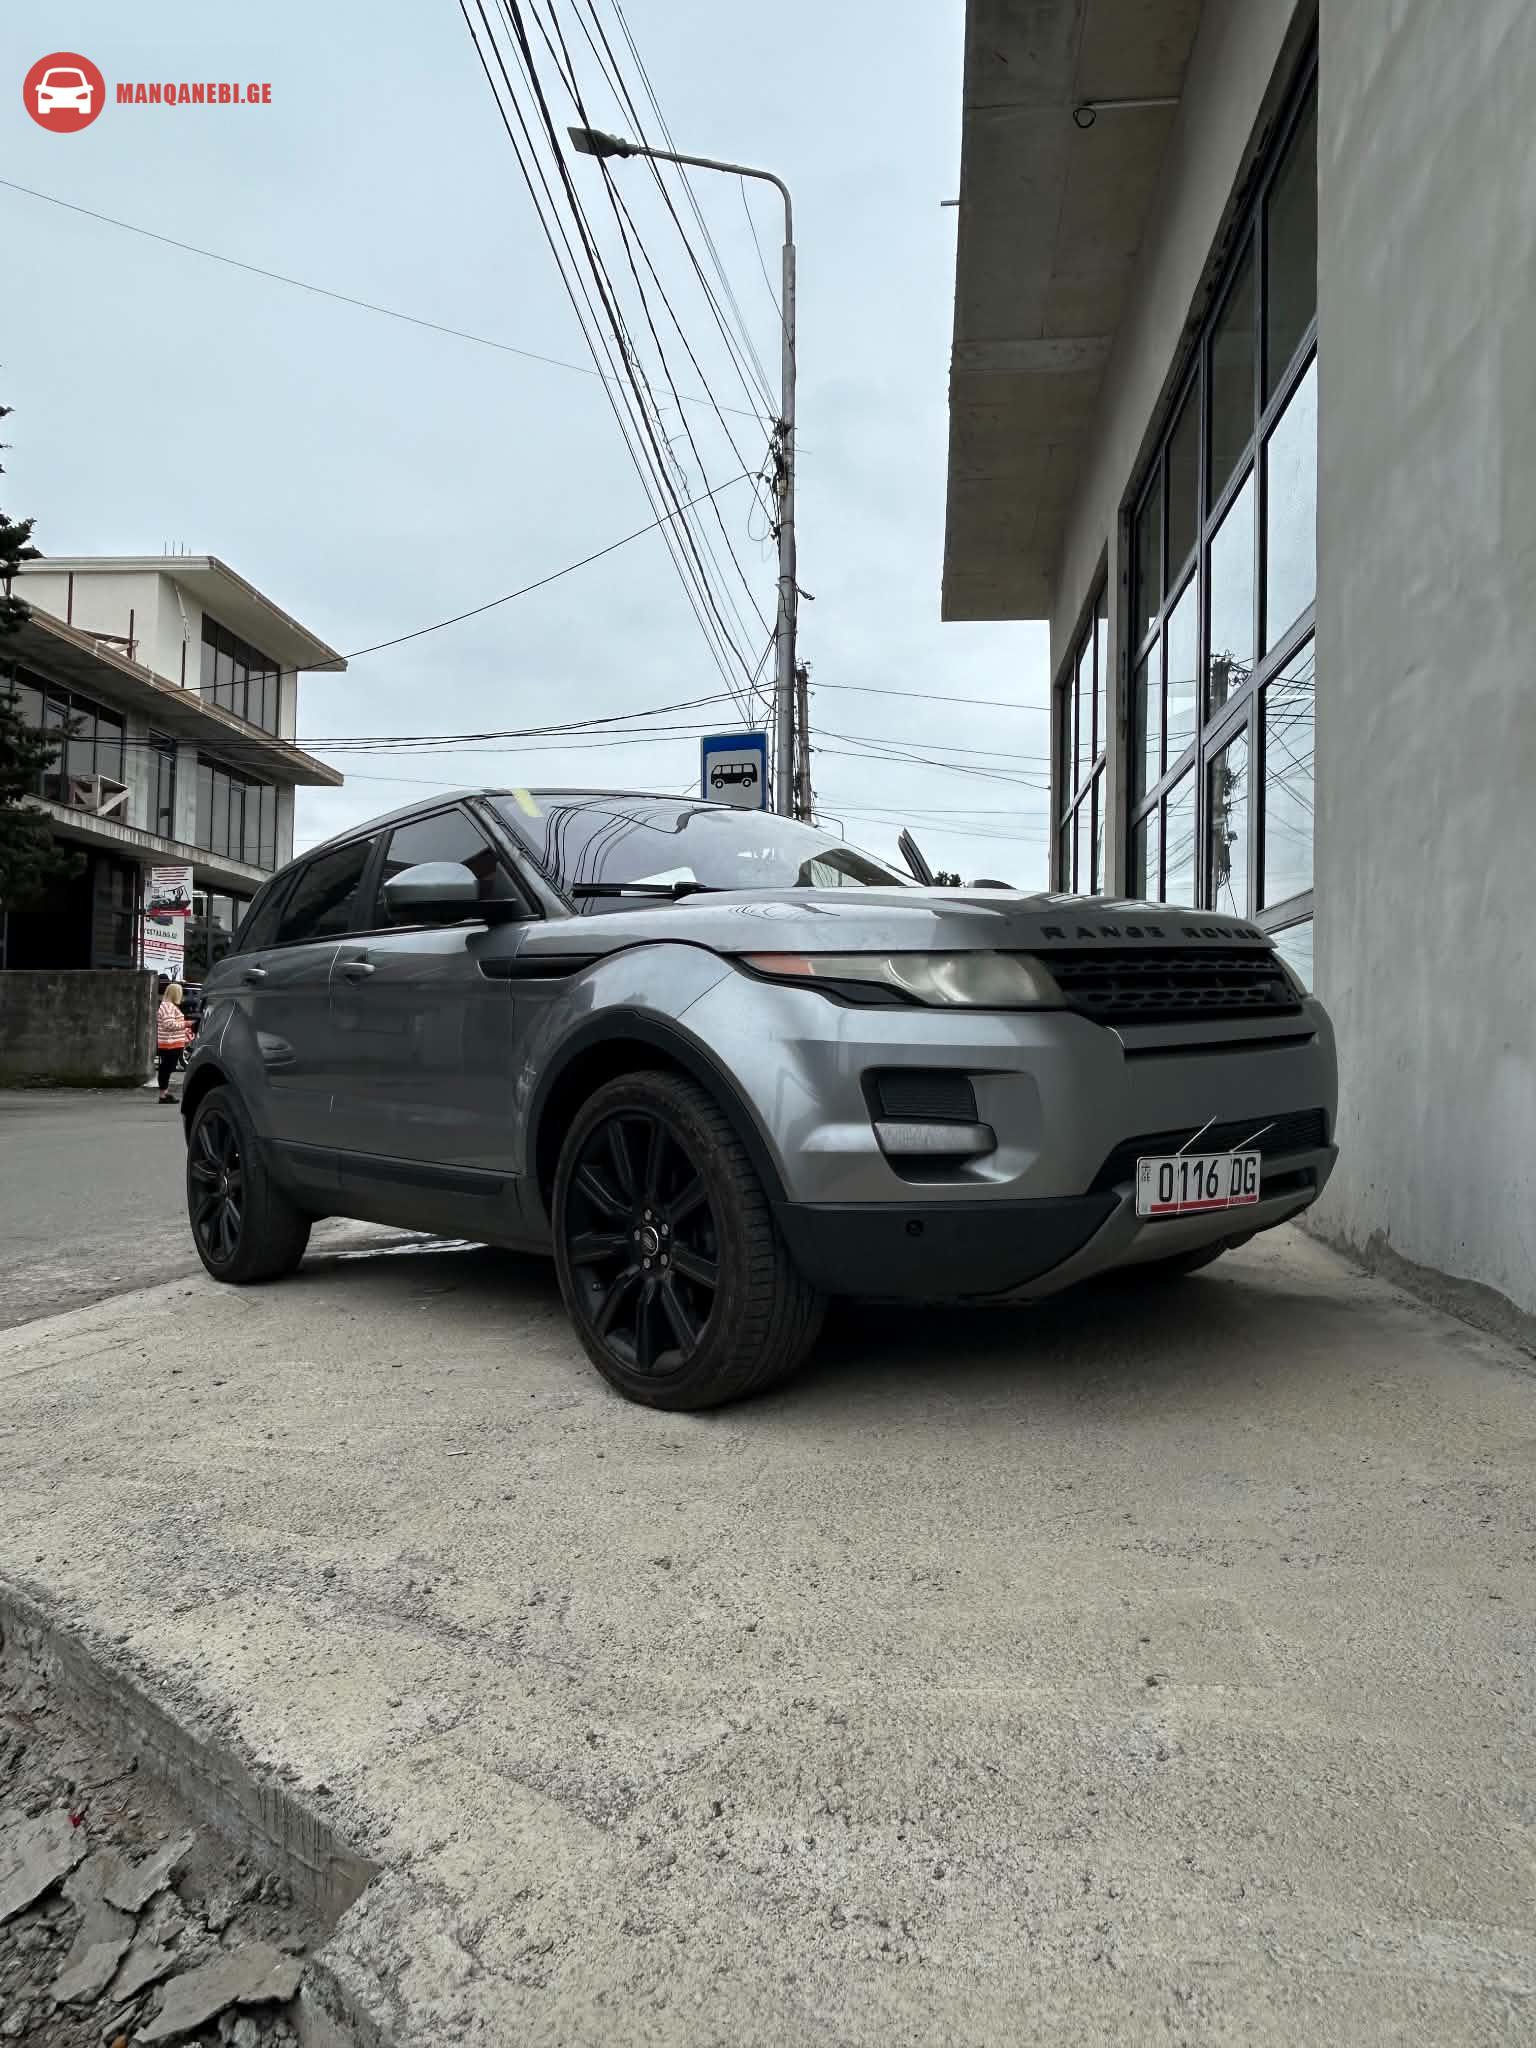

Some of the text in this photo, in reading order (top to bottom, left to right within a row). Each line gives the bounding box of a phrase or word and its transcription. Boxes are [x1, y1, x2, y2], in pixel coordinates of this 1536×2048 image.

[1039, 926, 1263, 941] RANGE ROVER
[1159, 1159, 1219, 1203] 0116
[1229, 1156, 1257, 1196] DG
